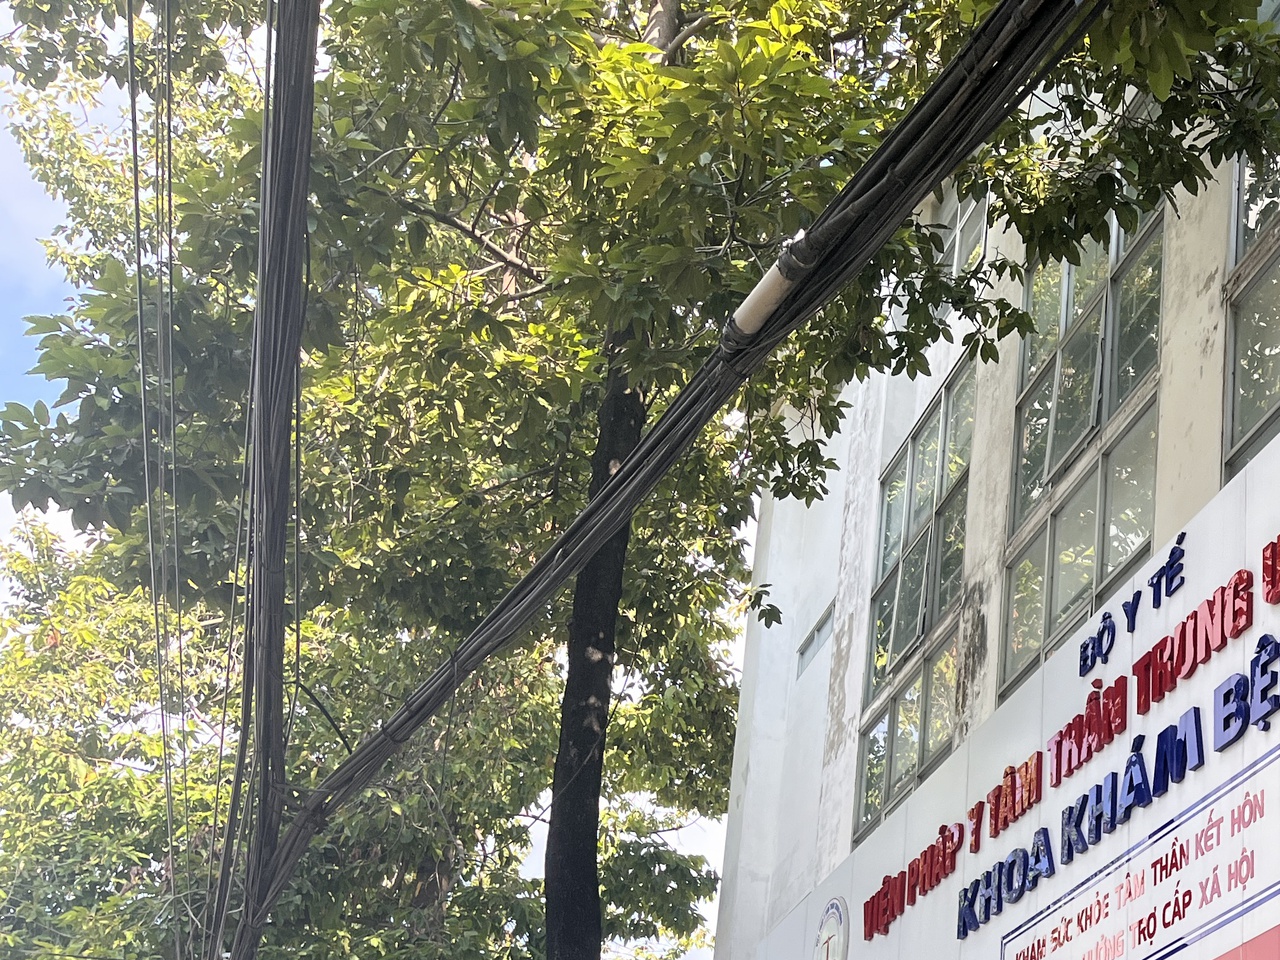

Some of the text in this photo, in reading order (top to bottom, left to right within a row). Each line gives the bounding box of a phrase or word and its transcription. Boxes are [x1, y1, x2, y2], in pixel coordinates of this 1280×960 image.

[1079, 532, 1187, 677] BỘ Y TẾ
[863, 870, 907, 941] VIỆN
[907, 823, 964, 906] PHÁP
[967, 801, 985, 853] Y
[987, 751, 1043, 838] TÂM
[1047, 678, 1128, 789] THẦN
[1132, 569, 1254, 715] TRUNG
[957, 827, 1056, 940] KHOA
[1060, 706, 1205, 866] KHÁM
[1115, 869, 1146, 911] TÂM
[1151, 837, 1190, 887] THẦN
[1194, 809, 1224, 861] KẾT
[1230, 789, 1265, 838] HÔN
[1162, 880, 1193, 929] CẤP
[1198, 865, 1221, 910] XÃ
[1227, 846, 1256, 892] HỘI
